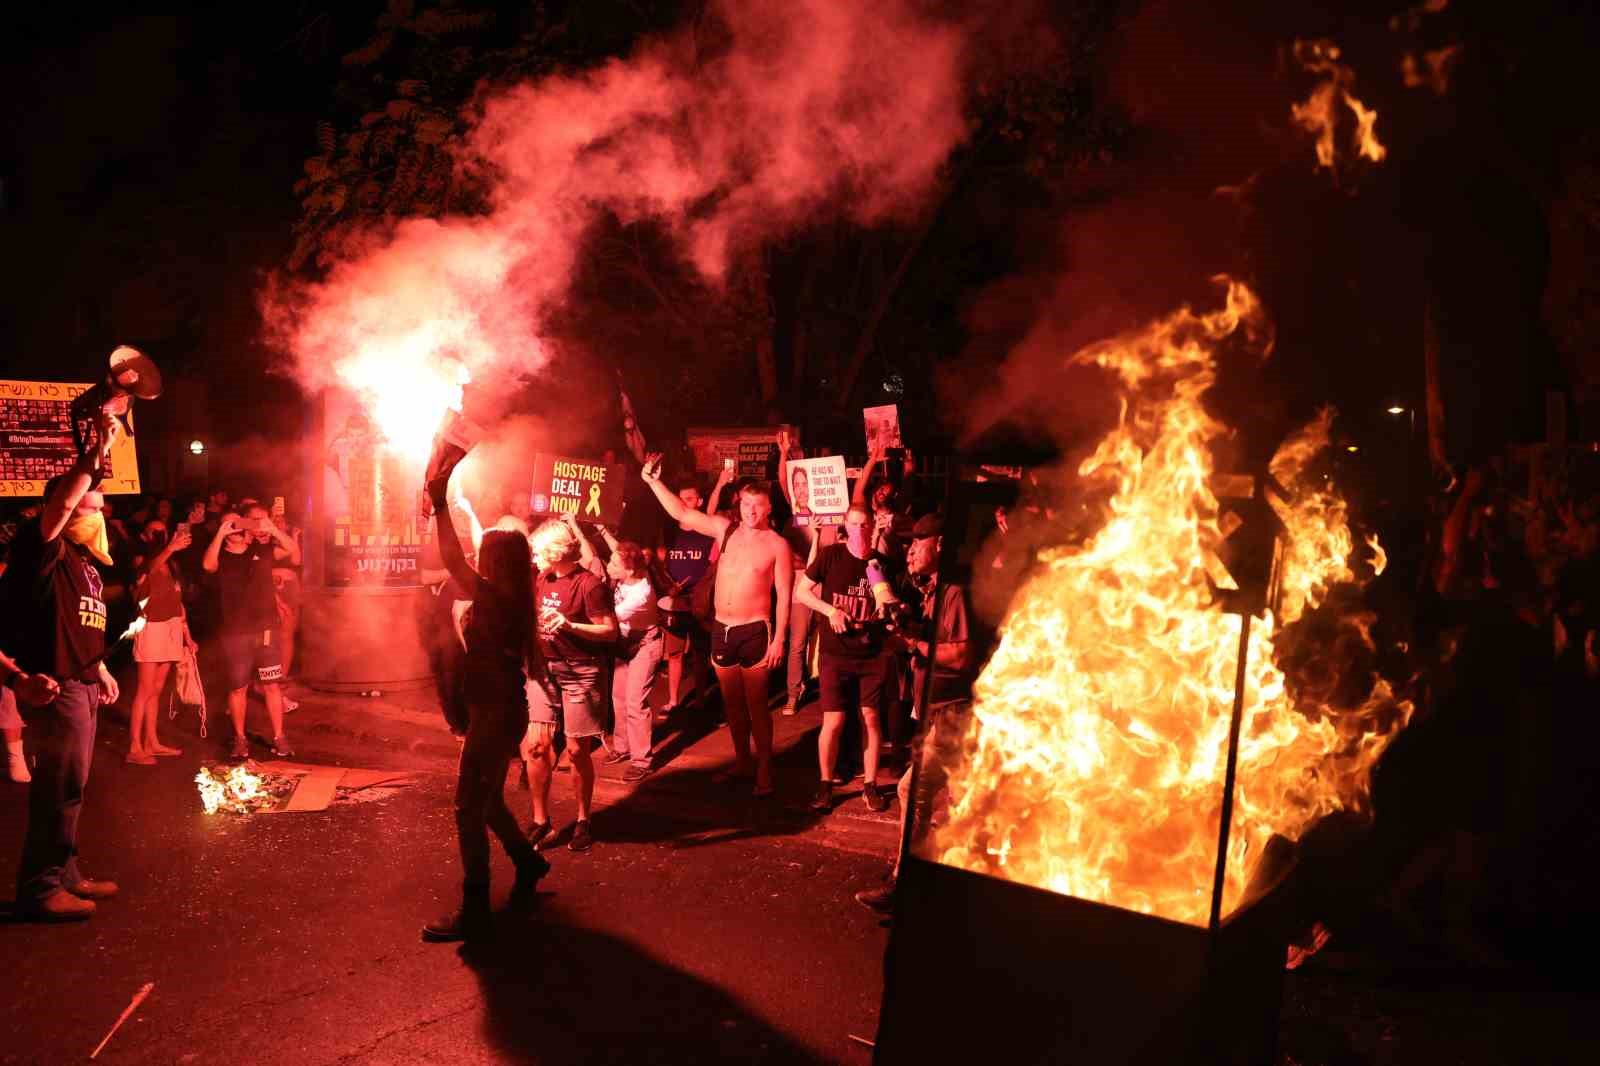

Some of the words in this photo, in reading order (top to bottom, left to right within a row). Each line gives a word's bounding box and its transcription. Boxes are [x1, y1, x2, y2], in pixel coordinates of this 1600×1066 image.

[553, 461, 606, 483] HOSTAGE
[551, 478, 581, 497] DEAL
[549, 495, 581, 514] NOW
[357, 558, 417, 573] בקולנוע
